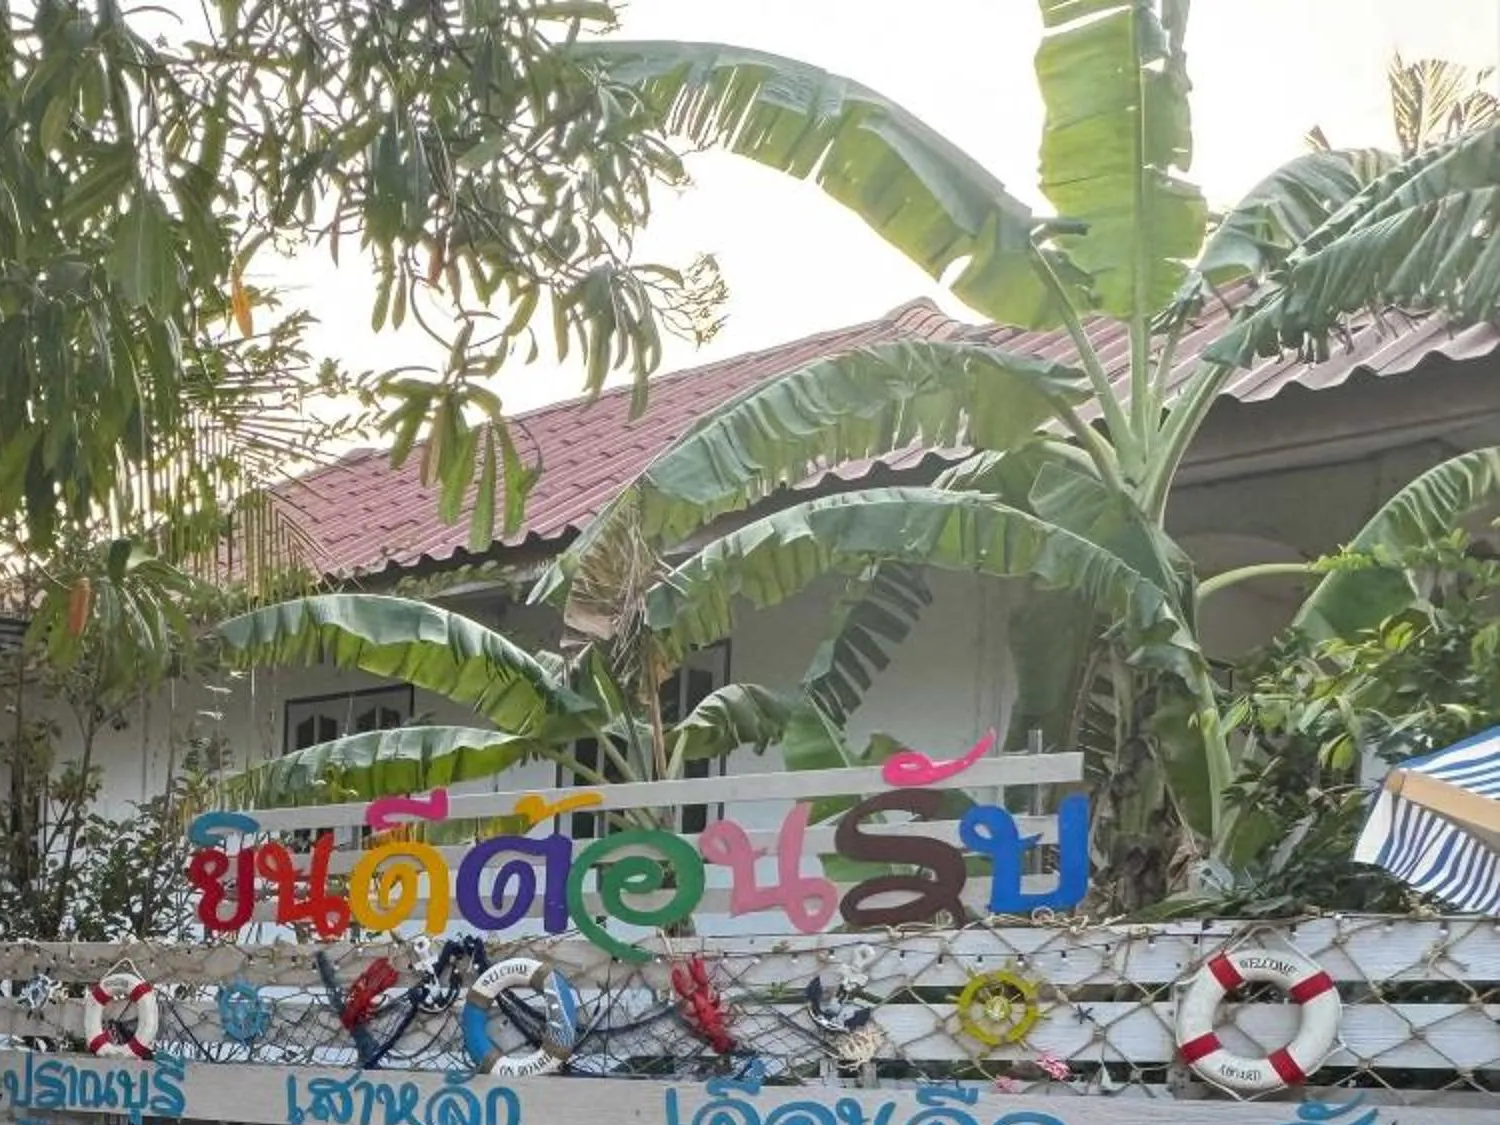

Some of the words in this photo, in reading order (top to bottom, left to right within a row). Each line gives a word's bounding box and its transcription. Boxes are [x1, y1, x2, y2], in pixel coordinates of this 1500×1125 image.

[185, 728, 1094, 963] ยินดีต้อนรับ
[1239, 957, 1298, 976] WELCOME
